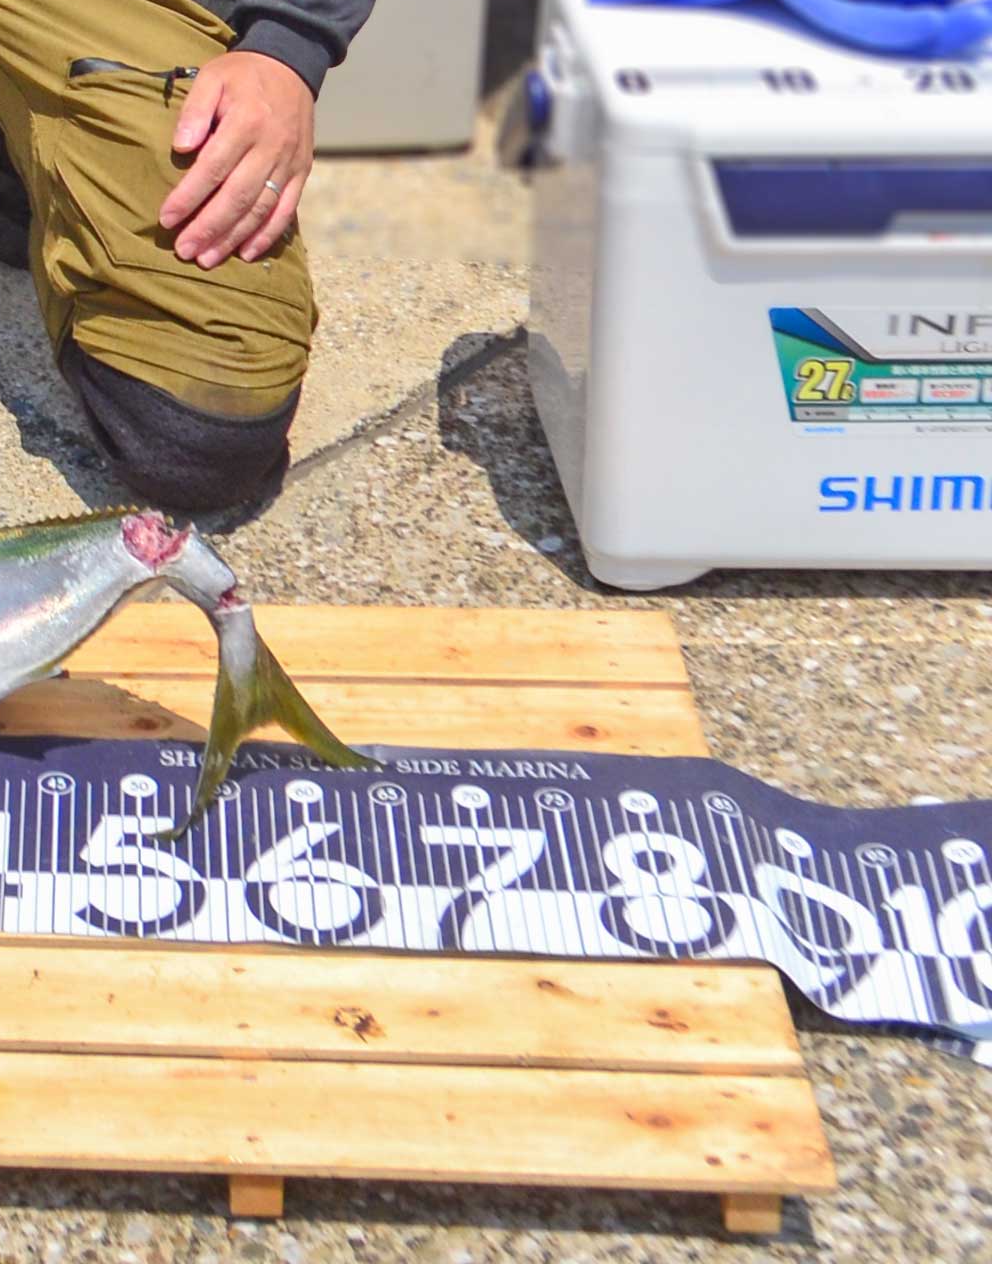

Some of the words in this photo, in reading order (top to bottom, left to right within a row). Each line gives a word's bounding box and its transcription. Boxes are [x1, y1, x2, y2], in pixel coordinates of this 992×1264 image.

[819, 475, 992, 512] SHIM
[396, 759, 461, 776] SIDE
[468, 759, 592, 780] MARINA
[75, 815, 207, 937] 5
[245, 822, 386, 942] 6
[420, 825, 546, 950] 7
[600, 832, 736, 958] 8
